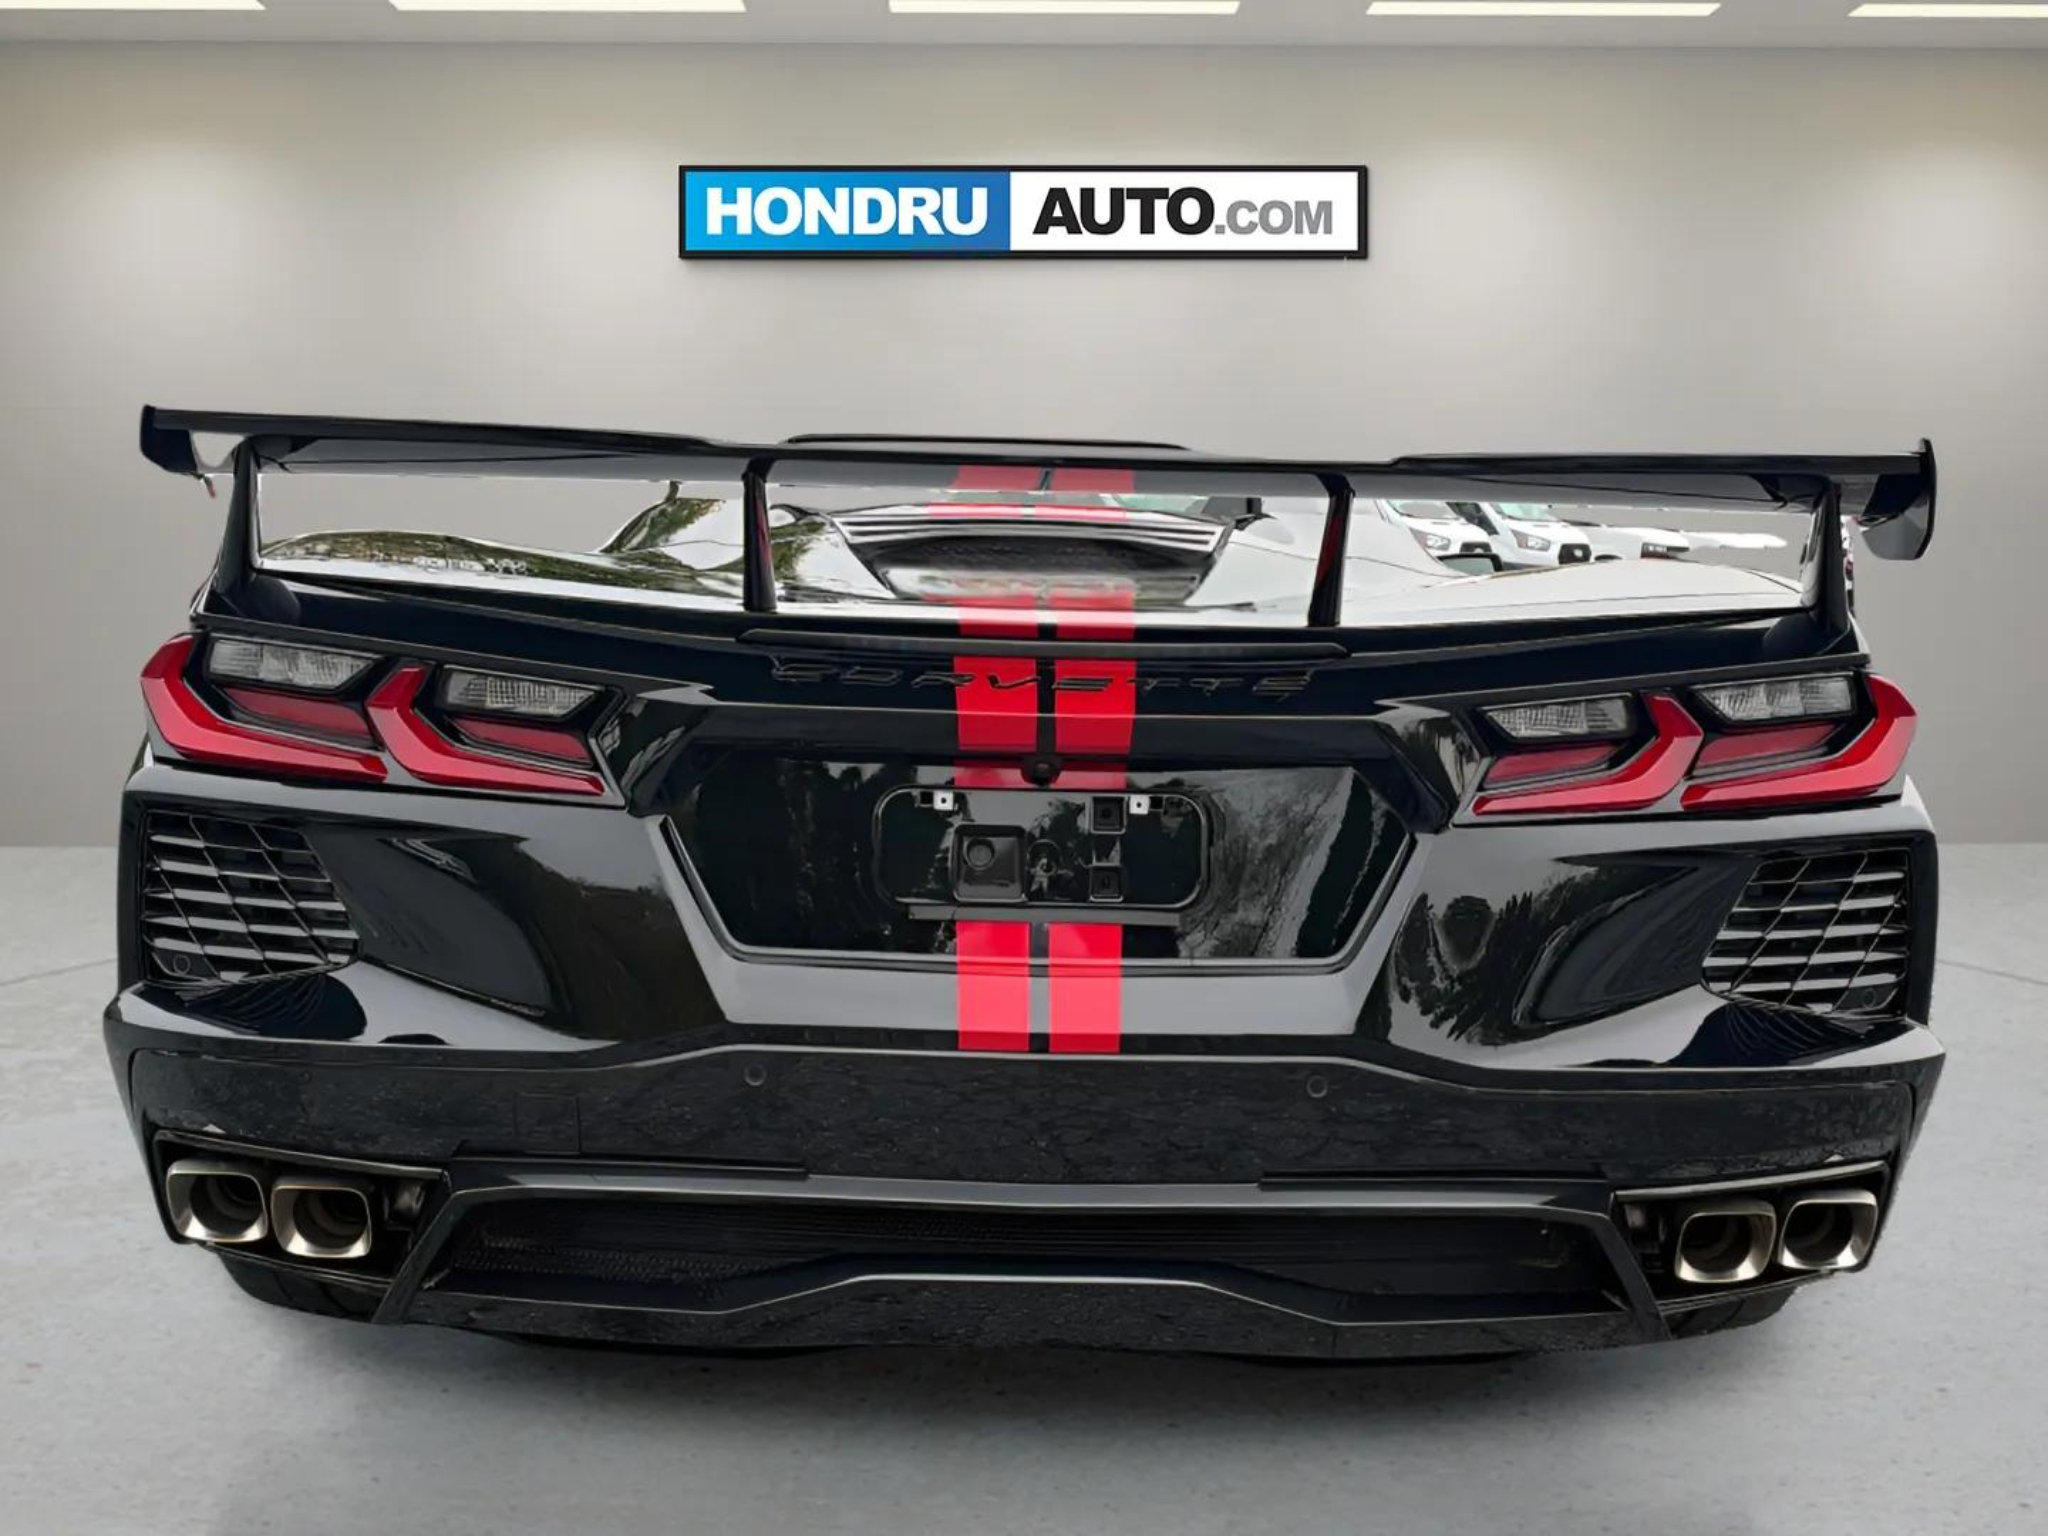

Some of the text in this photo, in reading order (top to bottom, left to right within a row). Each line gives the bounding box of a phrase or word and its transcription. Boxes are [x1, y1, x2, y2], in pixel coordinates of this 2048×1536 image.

[706, 187, 1333, 236] HONDRU AUTO.COM
[770, 660, 1314, 701] CORVETTE
